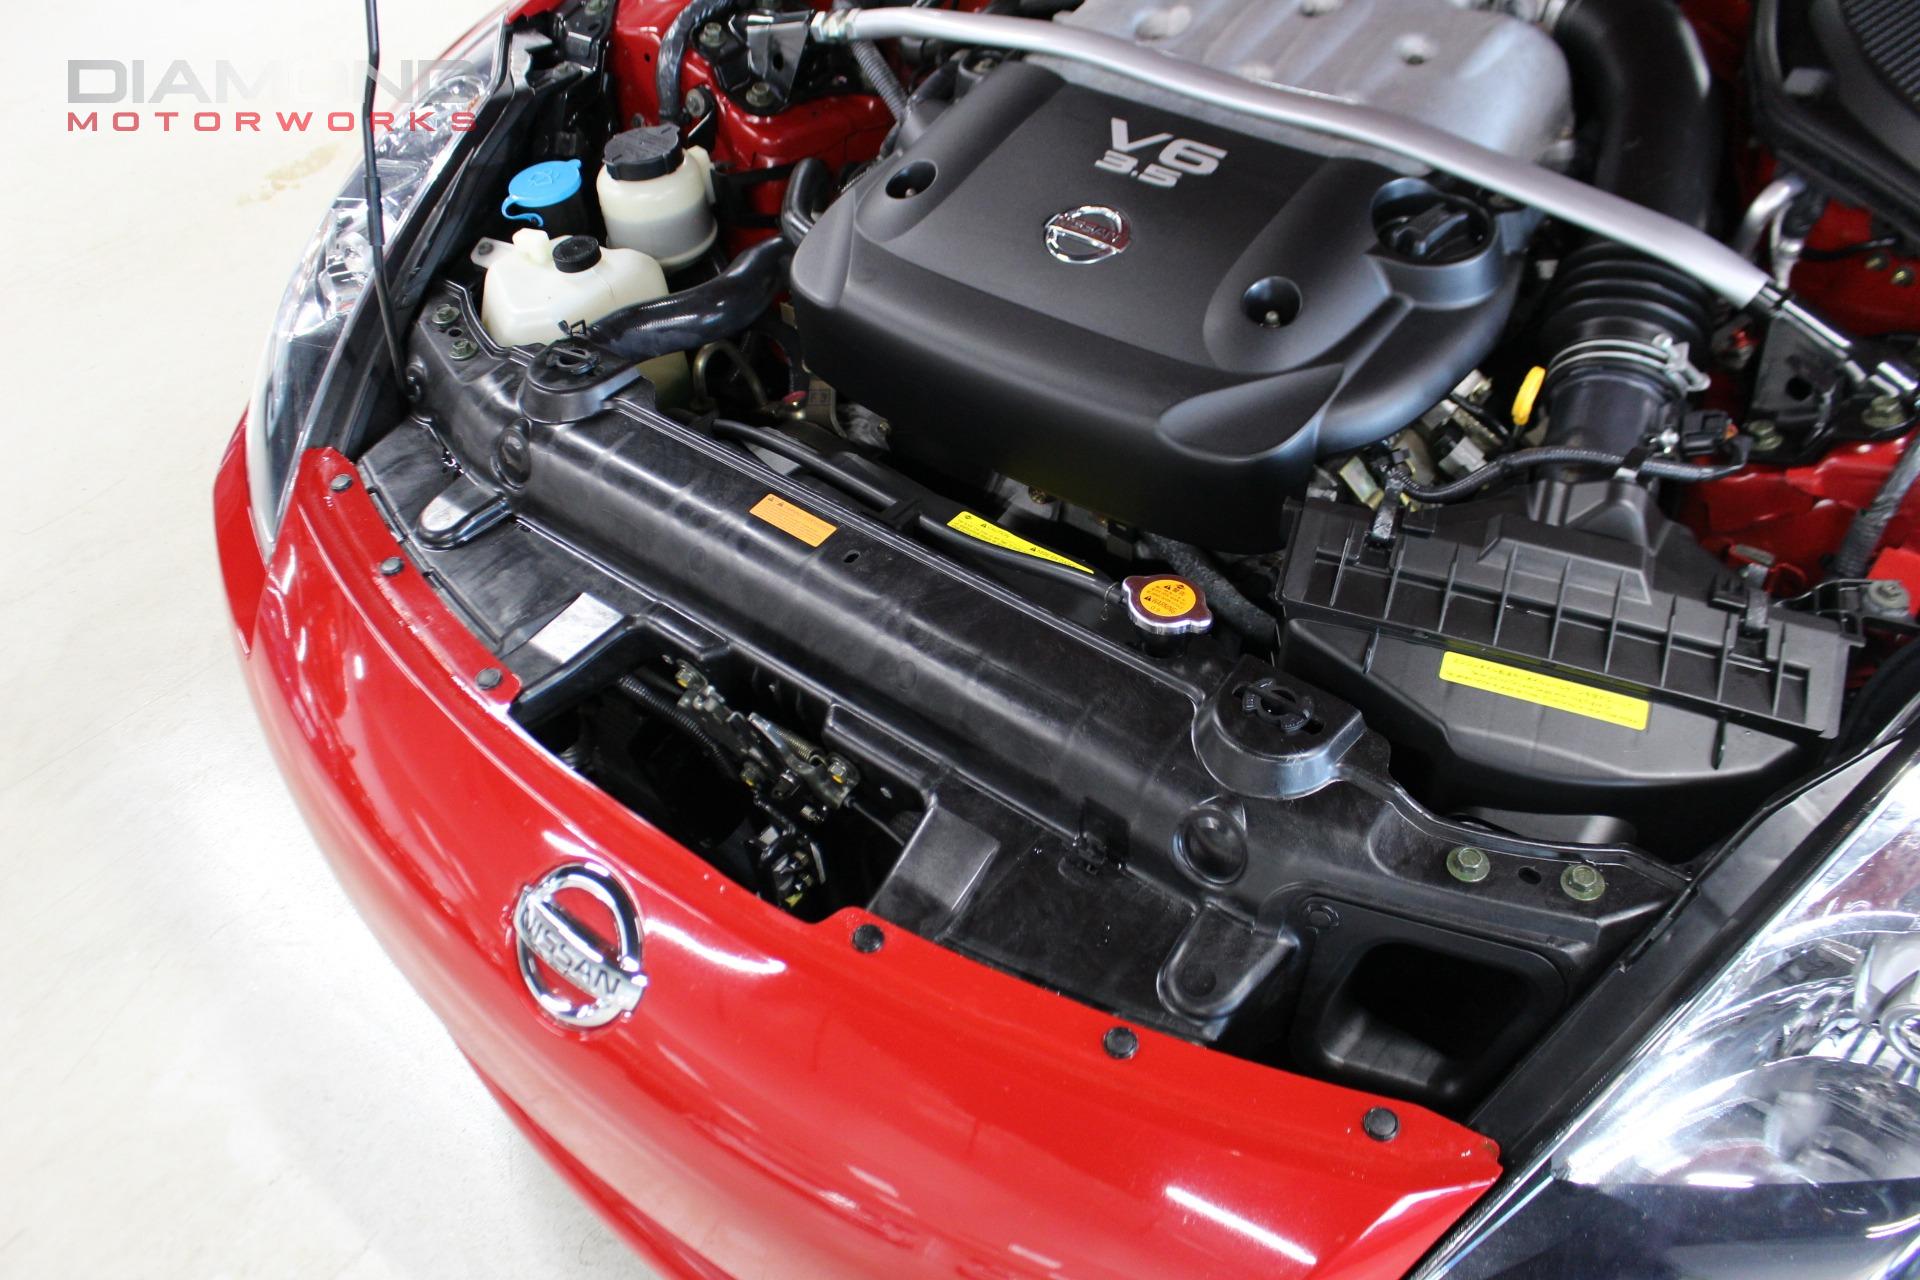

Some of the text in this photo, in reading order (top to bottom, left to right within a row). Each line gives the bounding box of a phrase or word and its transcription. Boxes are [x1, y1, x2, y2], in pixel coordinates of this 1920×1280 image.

[1094, 149, 1183, 188] 3.5
[1110, 116, 1229, 176] V6
[522, 908, 620, 994] NISSAN
